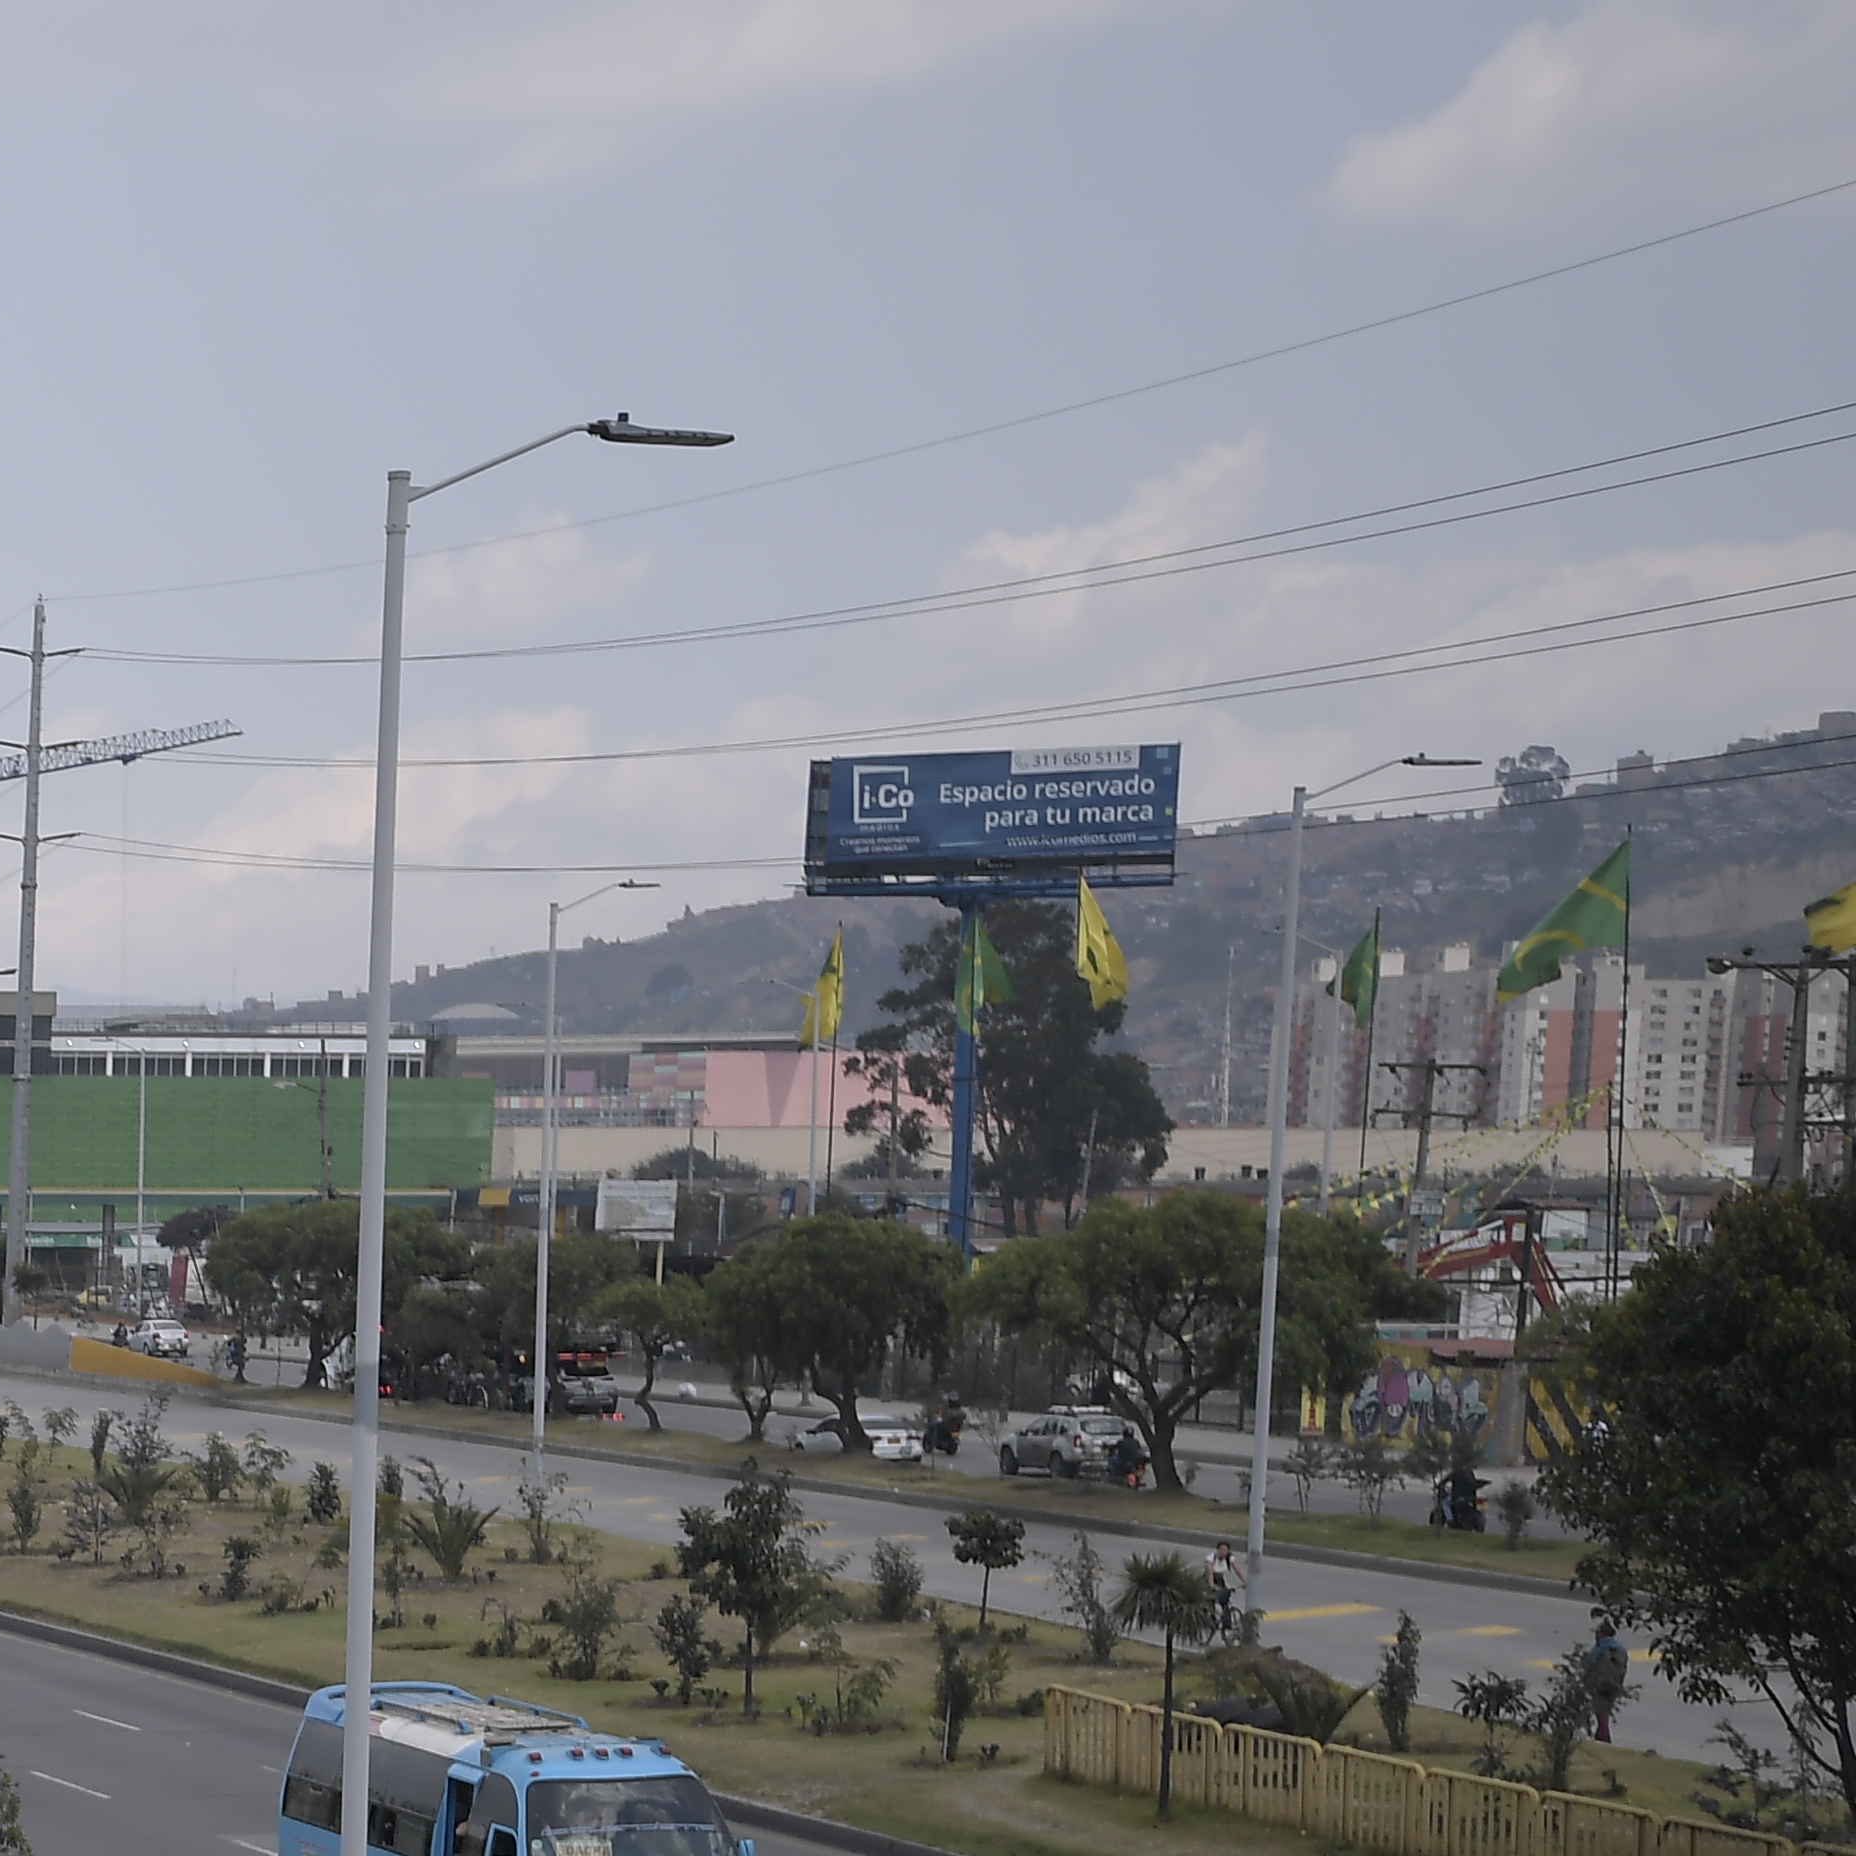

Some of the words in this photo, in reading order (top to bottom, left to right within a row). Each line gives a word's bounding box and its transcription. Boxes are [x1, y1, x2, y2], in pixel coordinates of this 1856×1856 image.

[1032, 752, 1058, 767] 311
[1063, 751, 1091, 766] 650
[1095, 750, 1133, 765] 5115
[939, 779, 1028, 808] Espacio
[1034, 773, 1156, 800] reservado
[985, 807, 1039, 833] para
[1045, 805, 1071, 825] tu
[1077, 803, 1154, 825] marca
